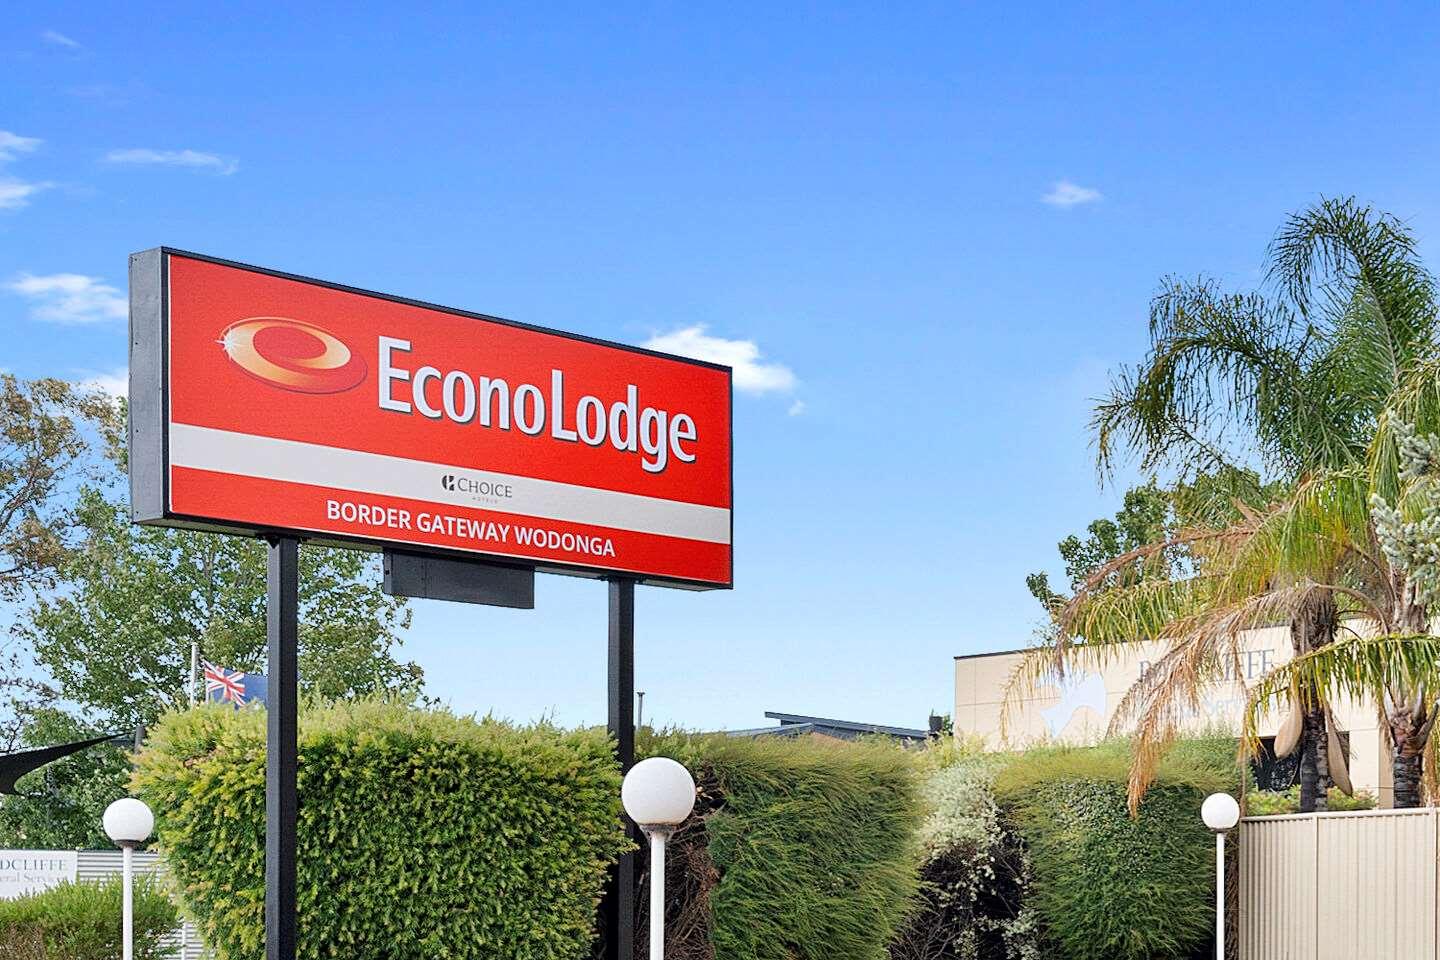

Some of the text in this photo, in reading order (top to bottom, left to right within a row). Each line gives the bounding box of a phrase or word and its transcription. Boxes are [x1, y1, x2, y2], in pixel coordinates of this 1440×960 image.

[377, 335, 698, 474] EconoLodge
[457, 477, 513, 498] CHOICE
[327, 499, 616, 558] BORDER GATEWAY WODONGA
